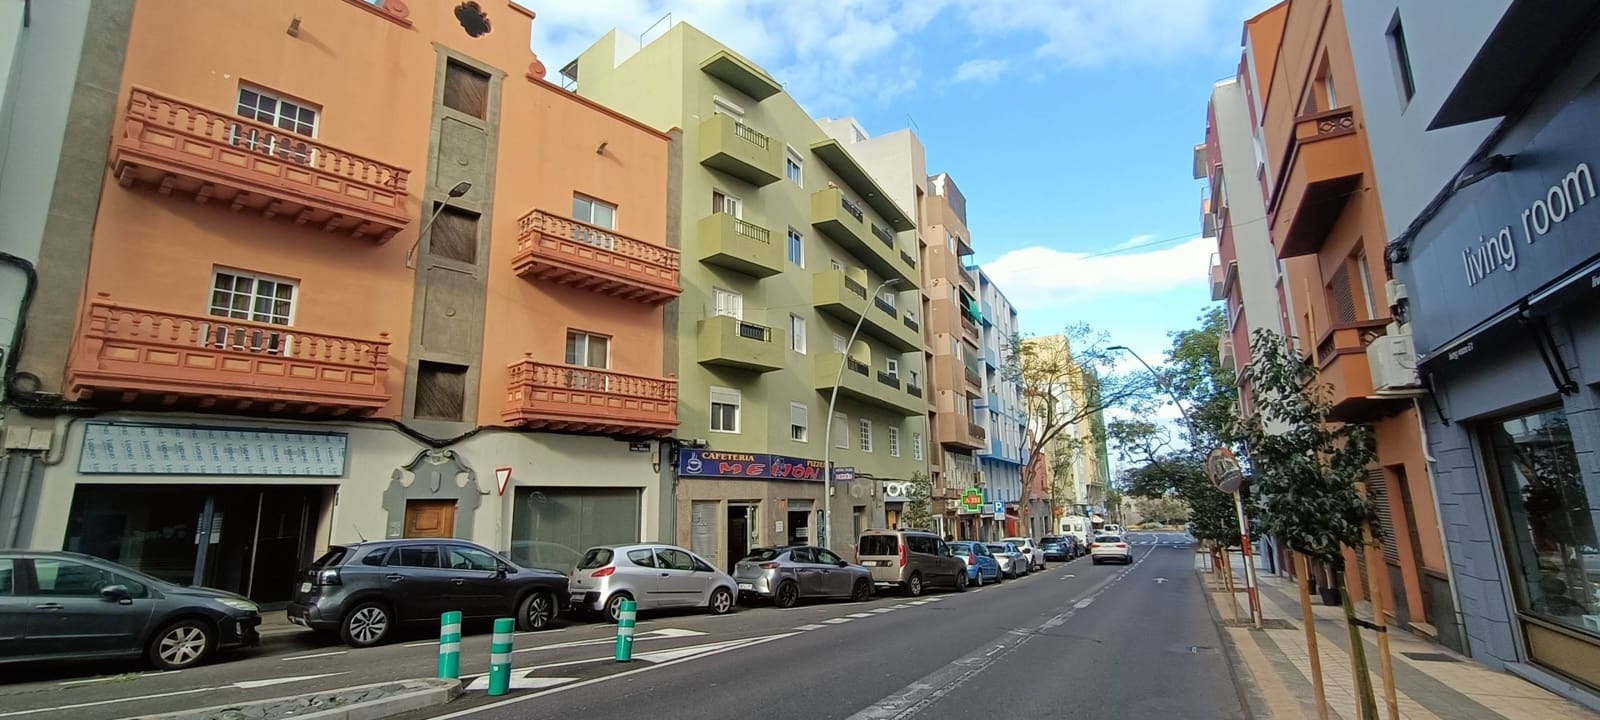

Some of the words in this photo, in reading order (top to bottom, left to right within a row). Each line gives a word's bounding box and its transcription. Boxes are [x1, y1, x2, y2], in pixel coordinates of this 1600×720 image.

[1461, 226, 1517, 287] living
[1520, 162, 1597, 244] room
[702, 452, 755, 462] CAFETERIA
[995, 501, 1003, 511] P
